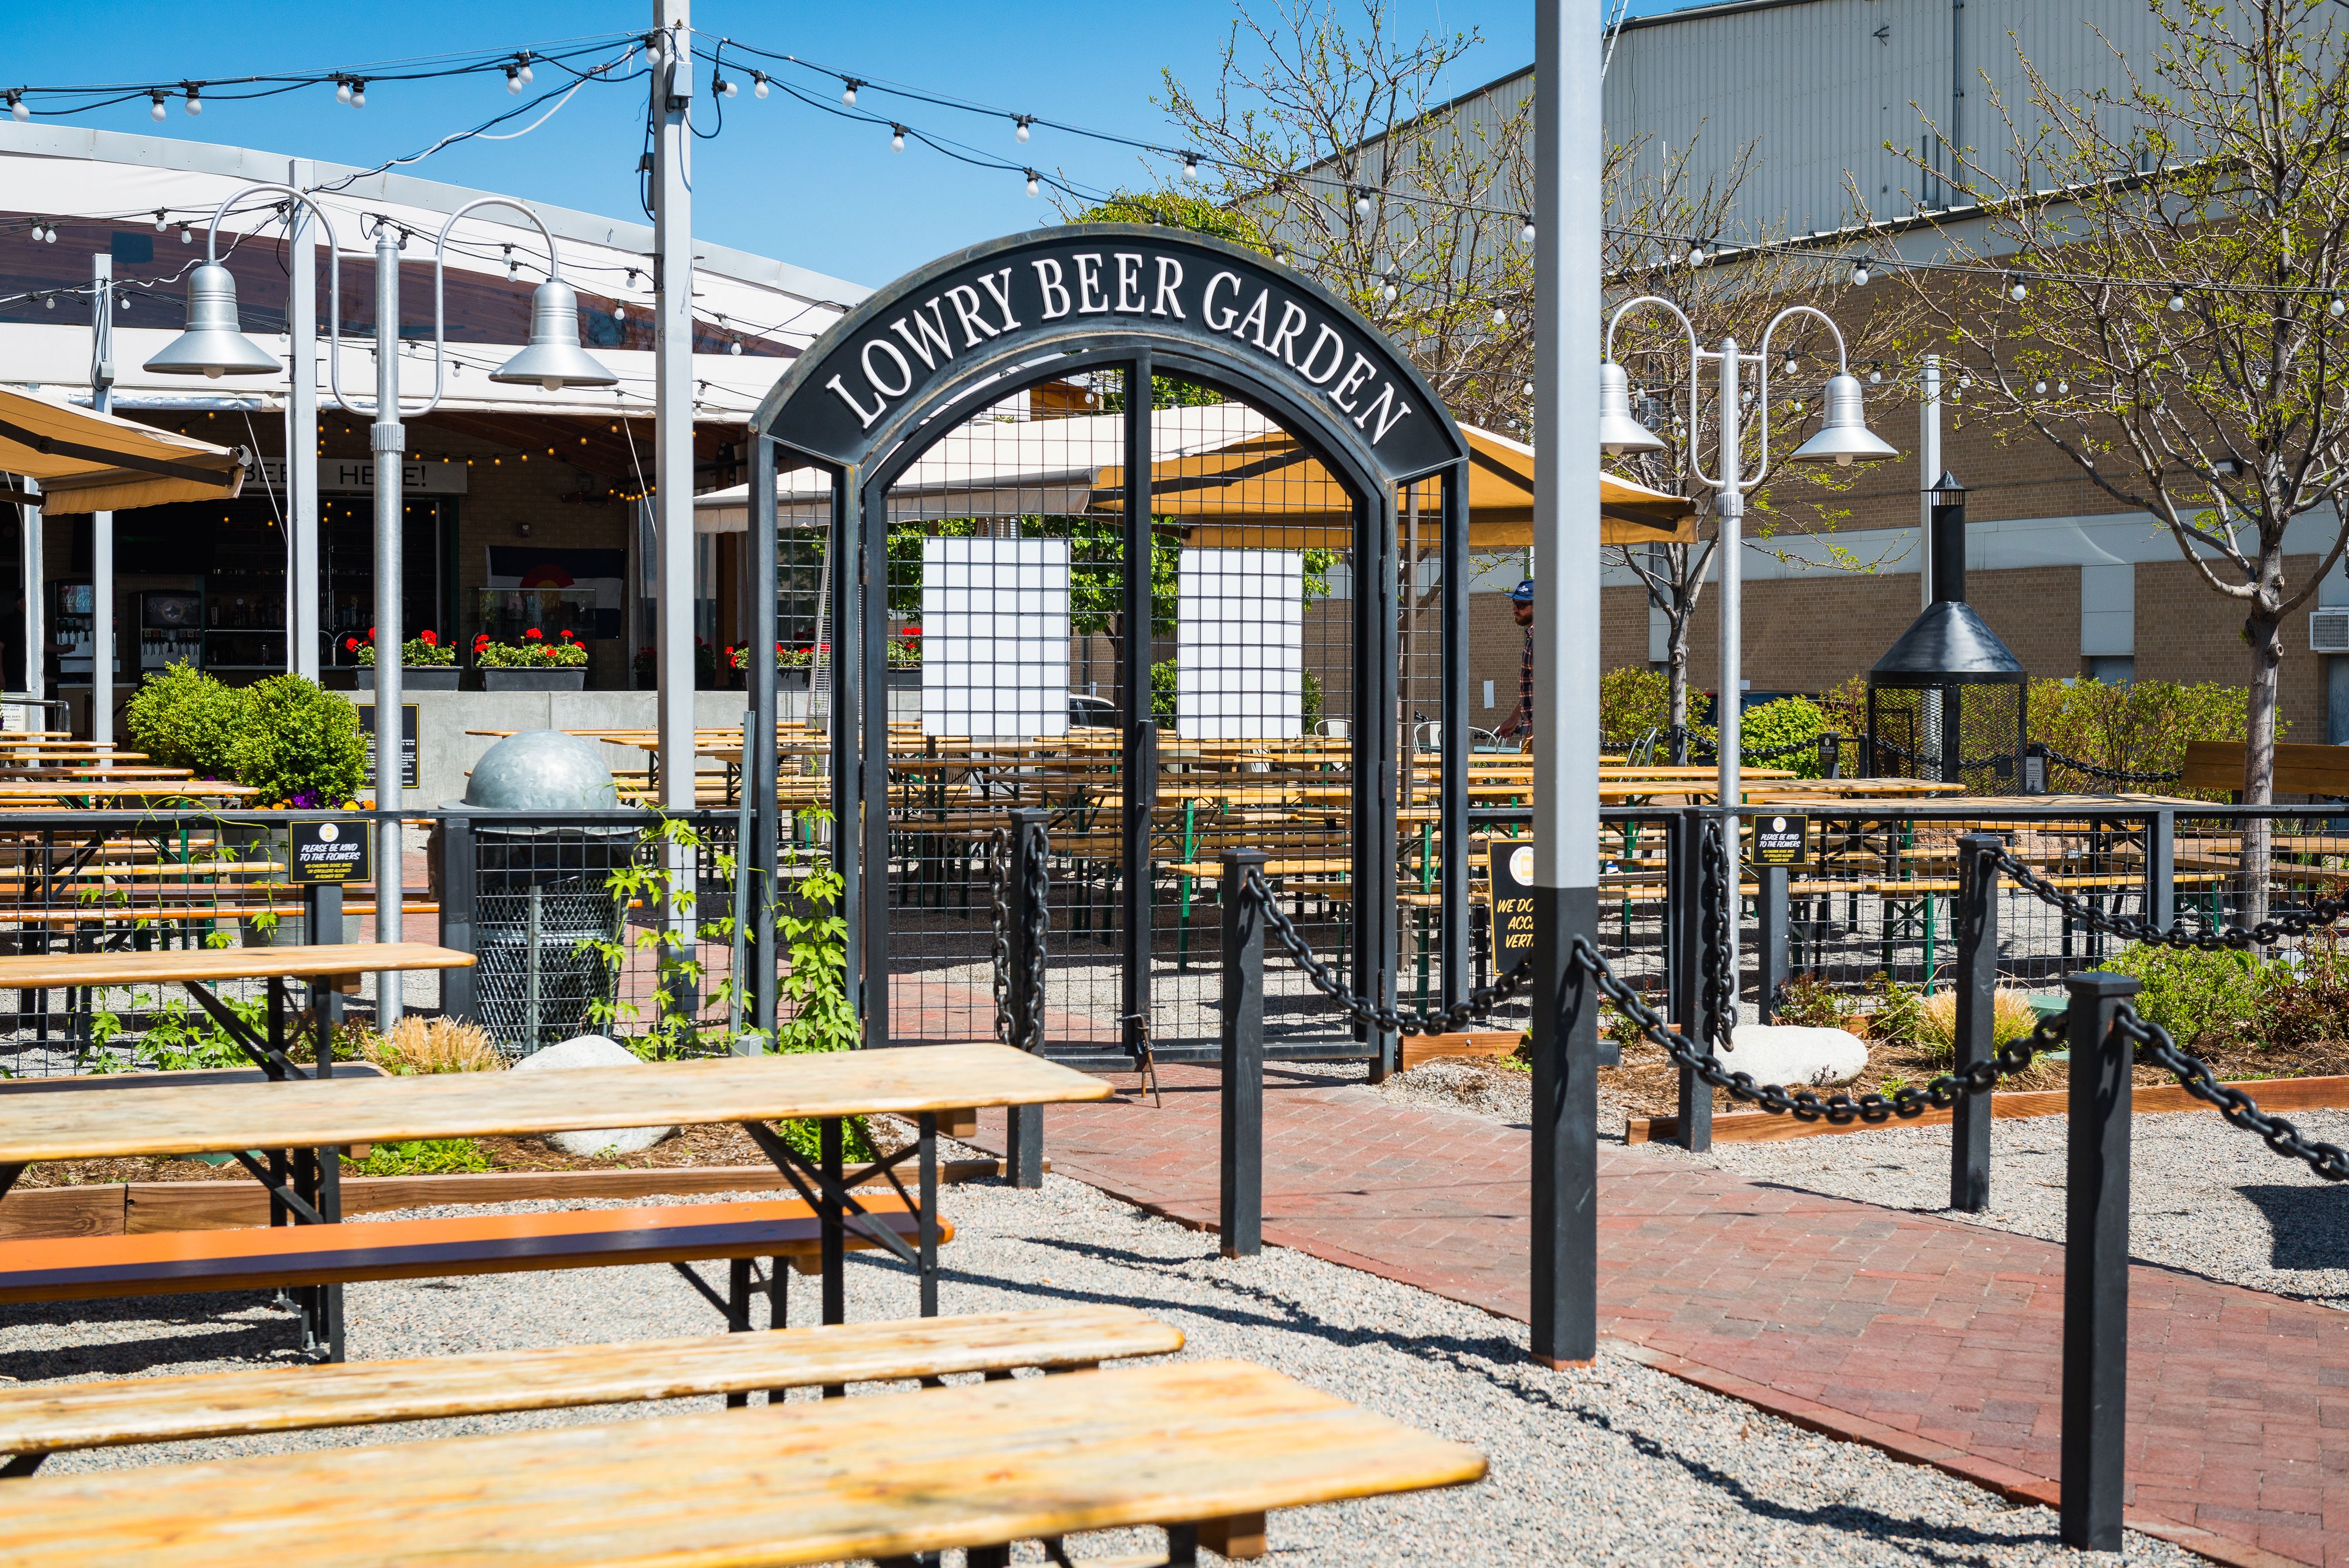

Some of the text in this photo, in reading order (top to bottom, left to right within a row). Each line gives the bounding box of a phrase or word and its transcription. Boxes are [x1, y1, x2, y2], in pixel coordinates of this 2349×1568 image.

[825, 253, 1412, 446] LOWRY BEER GARDEN
[243, 463, 426, 487] BE HEE!
[301, 844, 329, 852] PLEASE
[325, 852, 361, 860] FLOWERS
[1497, 899, 1516, 913] WE
[1508, 916, 1533, 930] ACC
[1506, 934, 1533, 948] VERT
